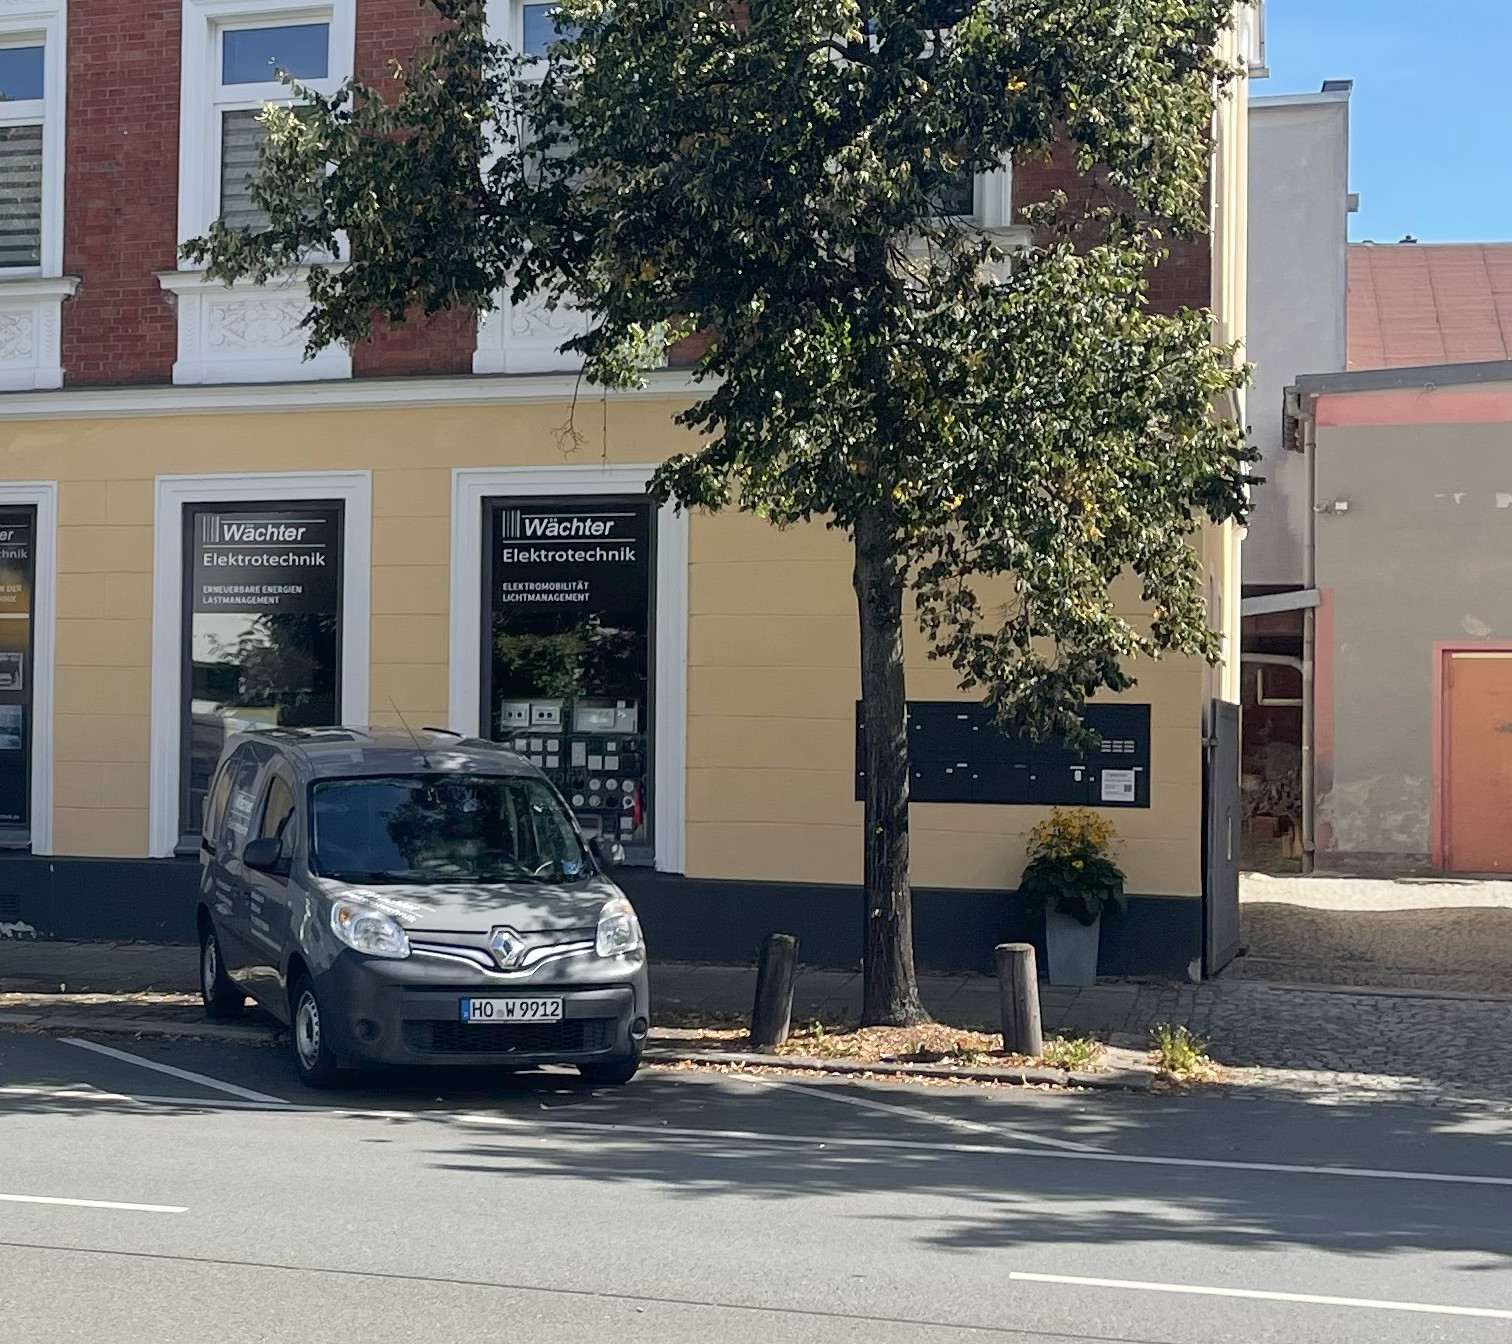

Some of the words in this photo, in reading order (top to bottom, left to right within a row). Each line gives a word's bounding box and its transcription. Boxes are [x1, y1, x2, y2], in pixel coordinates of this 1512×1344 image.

[223, 524, 306, 541] Wächter
[525, 517, 615, 536] Wächter
[203, 552, 326, 566] Elektrotechnik
[503, 546, 636, 562] Elektrotechnik
[202, 585, 260, 594] ERNEUERBARE
[262, 585, 303, 593] ENERGIEN
[502, 580, 589, 591] ELEKTROMOBILITÄT
[202, 596, 280, 605] LASTMANAGEMENT
[502, 593, 590, 602] LICHTMANAGEMENT
[472, 1001, 494, 1018] HO
[519, 1000, 560, 1018] 9912
